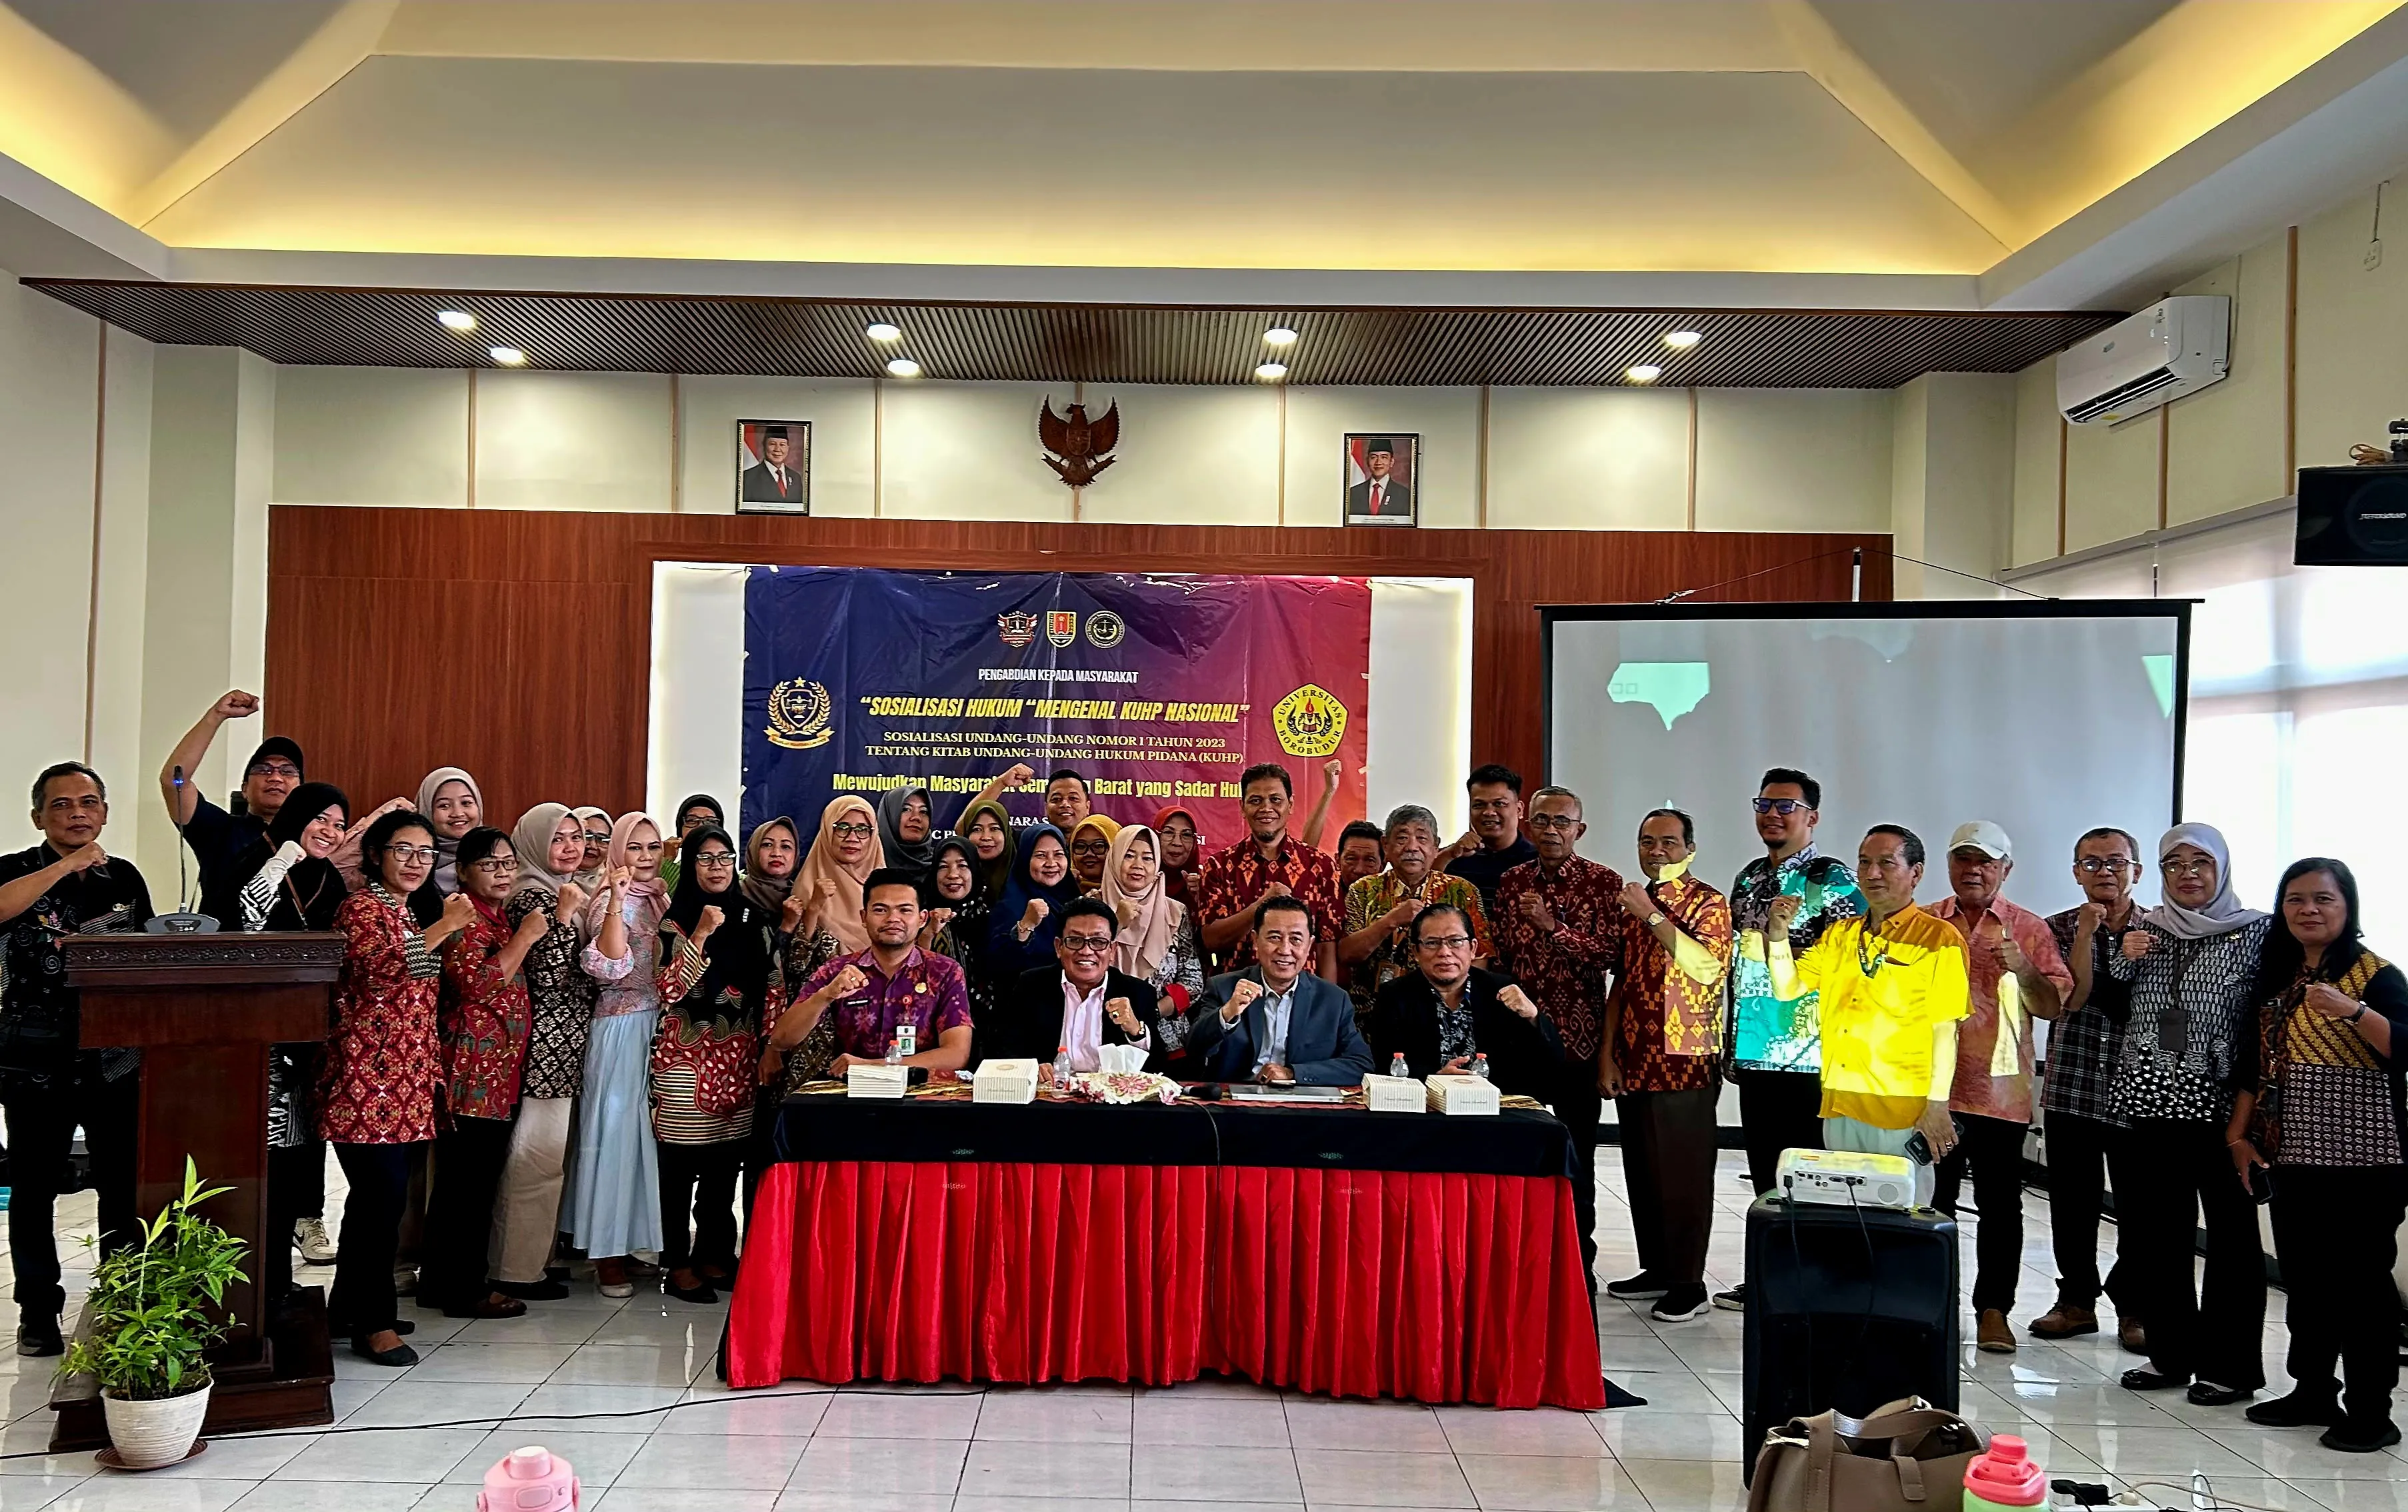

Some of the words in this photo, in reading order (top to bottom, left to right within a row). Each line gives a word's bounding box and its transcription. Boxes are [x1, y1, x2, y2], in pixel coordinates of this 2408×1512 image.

[978, 668, 1037, 681] PENGABDIAN
[1037, 669, 1073, 682] KEPADA
[1075, 670, 1139, 683] MASYARAKAT
[965, 698, 1024, 717] HUKUM
[1119, 701, 1163, 721] KUHP
[1279, 689, 1343, 719] UNIVERSITAS
[883, 731, 963, 743] SOSIALISASI
[965, 733, 1084, 745] UNDANG-UNDANG
[1086, 735, 1137, 746] NOMOR
[1145, 737, 1193, 747] TAHUN
[1195, 737, 1226, 748] 2023
[1279, 729, 1341, 755] BOROBUDUR
[865, 745, 930, 756] TENTANG
[932, 747, 971, 757] KITAB
[973, 747, 1093, 759] UNDANG-UNDANG
[1094, 749, 1145, 761] HUKUM
[1147, 751, 1197, 762] PIDANA
[1199, 751, 1245, 765] (KUHP)
[833, 773, 927, 793] Mewujudkan
[930, 775, 1016, 794] Masyara
[1094, 778, 1133, 795] Barat
[1135, 781, 1171, 798] yang
[1175, 780, 1217, 797] Sadar
